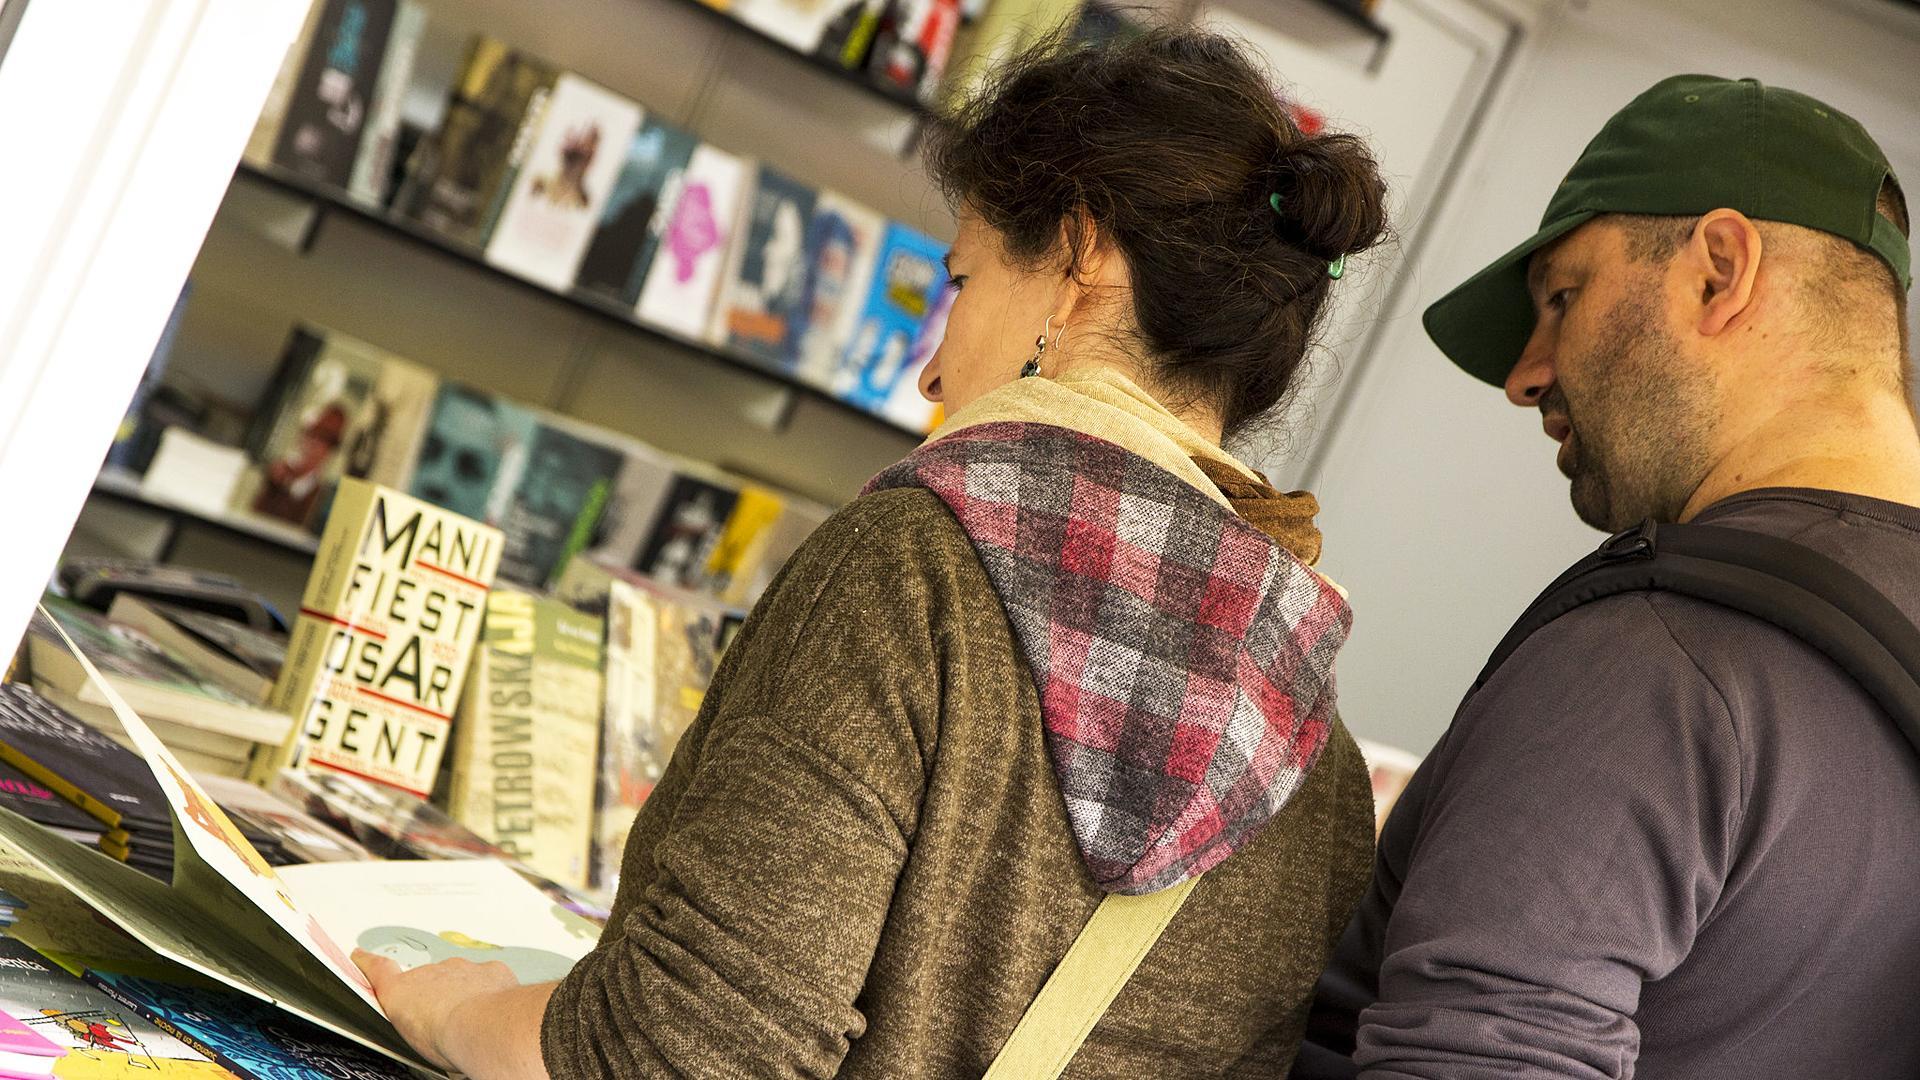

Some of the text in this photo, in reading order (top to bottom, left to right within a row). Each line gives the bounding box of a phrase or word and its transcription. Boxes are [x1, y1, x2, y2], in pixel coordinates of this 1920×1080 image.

[361, 497, 491, 579] MANI
[345, 563, 475, 642] FIEST
[305, 699, 437, 773] GENT
